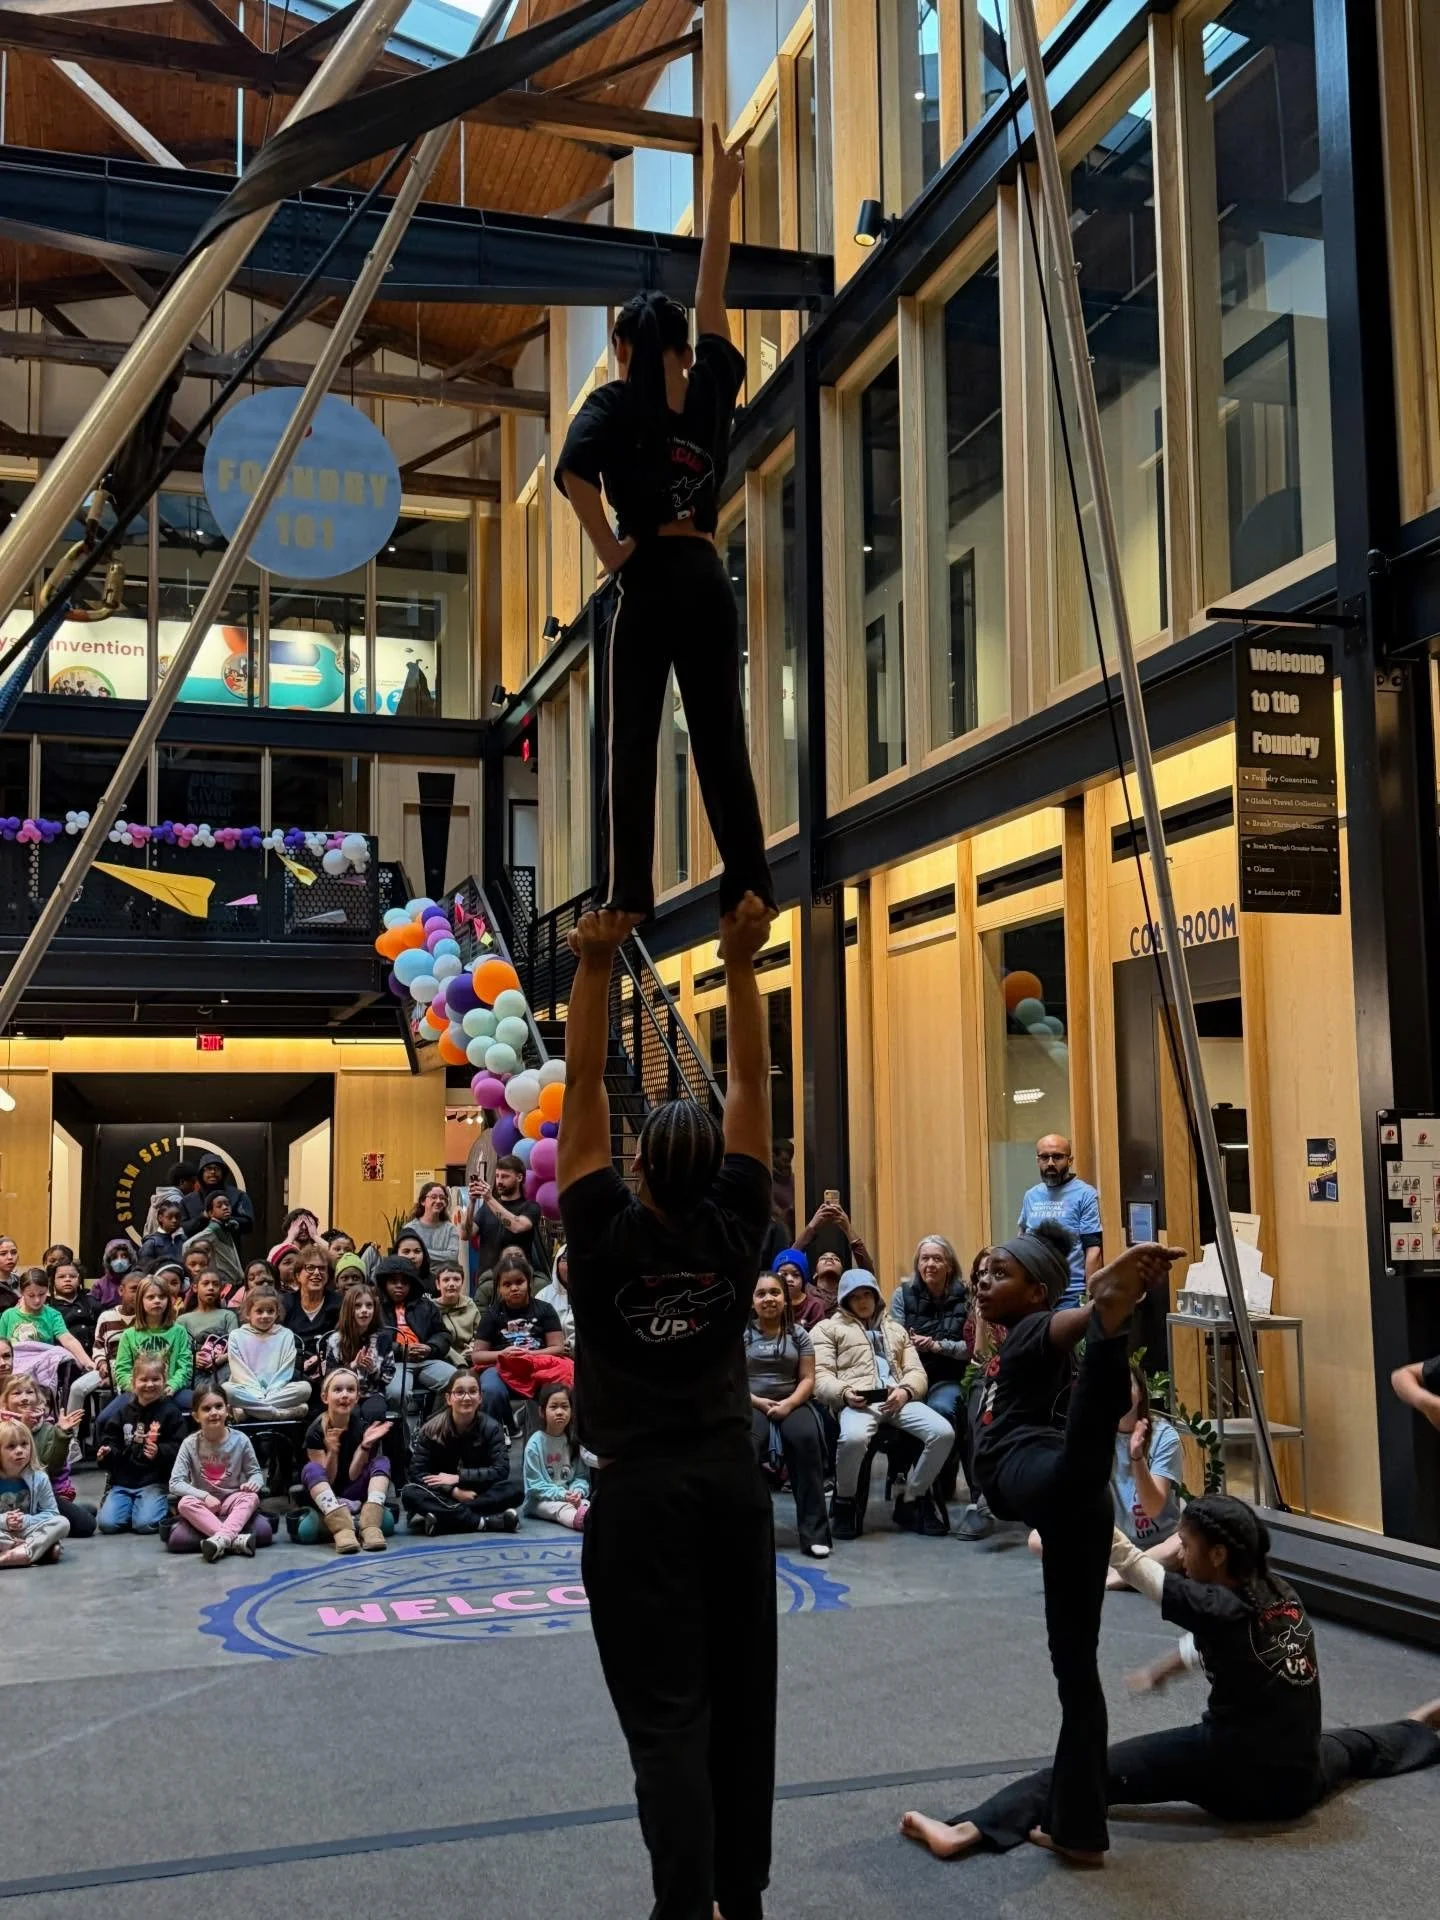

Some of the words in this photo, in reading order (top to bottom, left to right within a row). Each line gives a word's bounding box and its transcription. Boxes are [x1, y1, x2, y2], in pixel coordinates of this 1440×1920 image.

[275, 512, 335, 550] 101
[1249, 648, 1325, 675] Welcome
[1251, 689, 1270, 713] to
[1271, 691, 1300, 714] the
[1252, 730, 1320, 759] Foundry
[1251, 774, 1279, 784] Foundry
[1279, 775, 1318, 785] Consortium
[1272, 798, 1294, 807] Travel
[1182, 902, 1237, 946] ROOM
[200, 1035, 221, 1050] EXIT
[115, 1164, 141, 1222] STEAM
[138, 1137, 171, 1163] SET
[320, 1567, 408, 1590] THE
[422, 1549, 574, 1569] FOUN
[316, 1585, 589, 1628] WELCO
